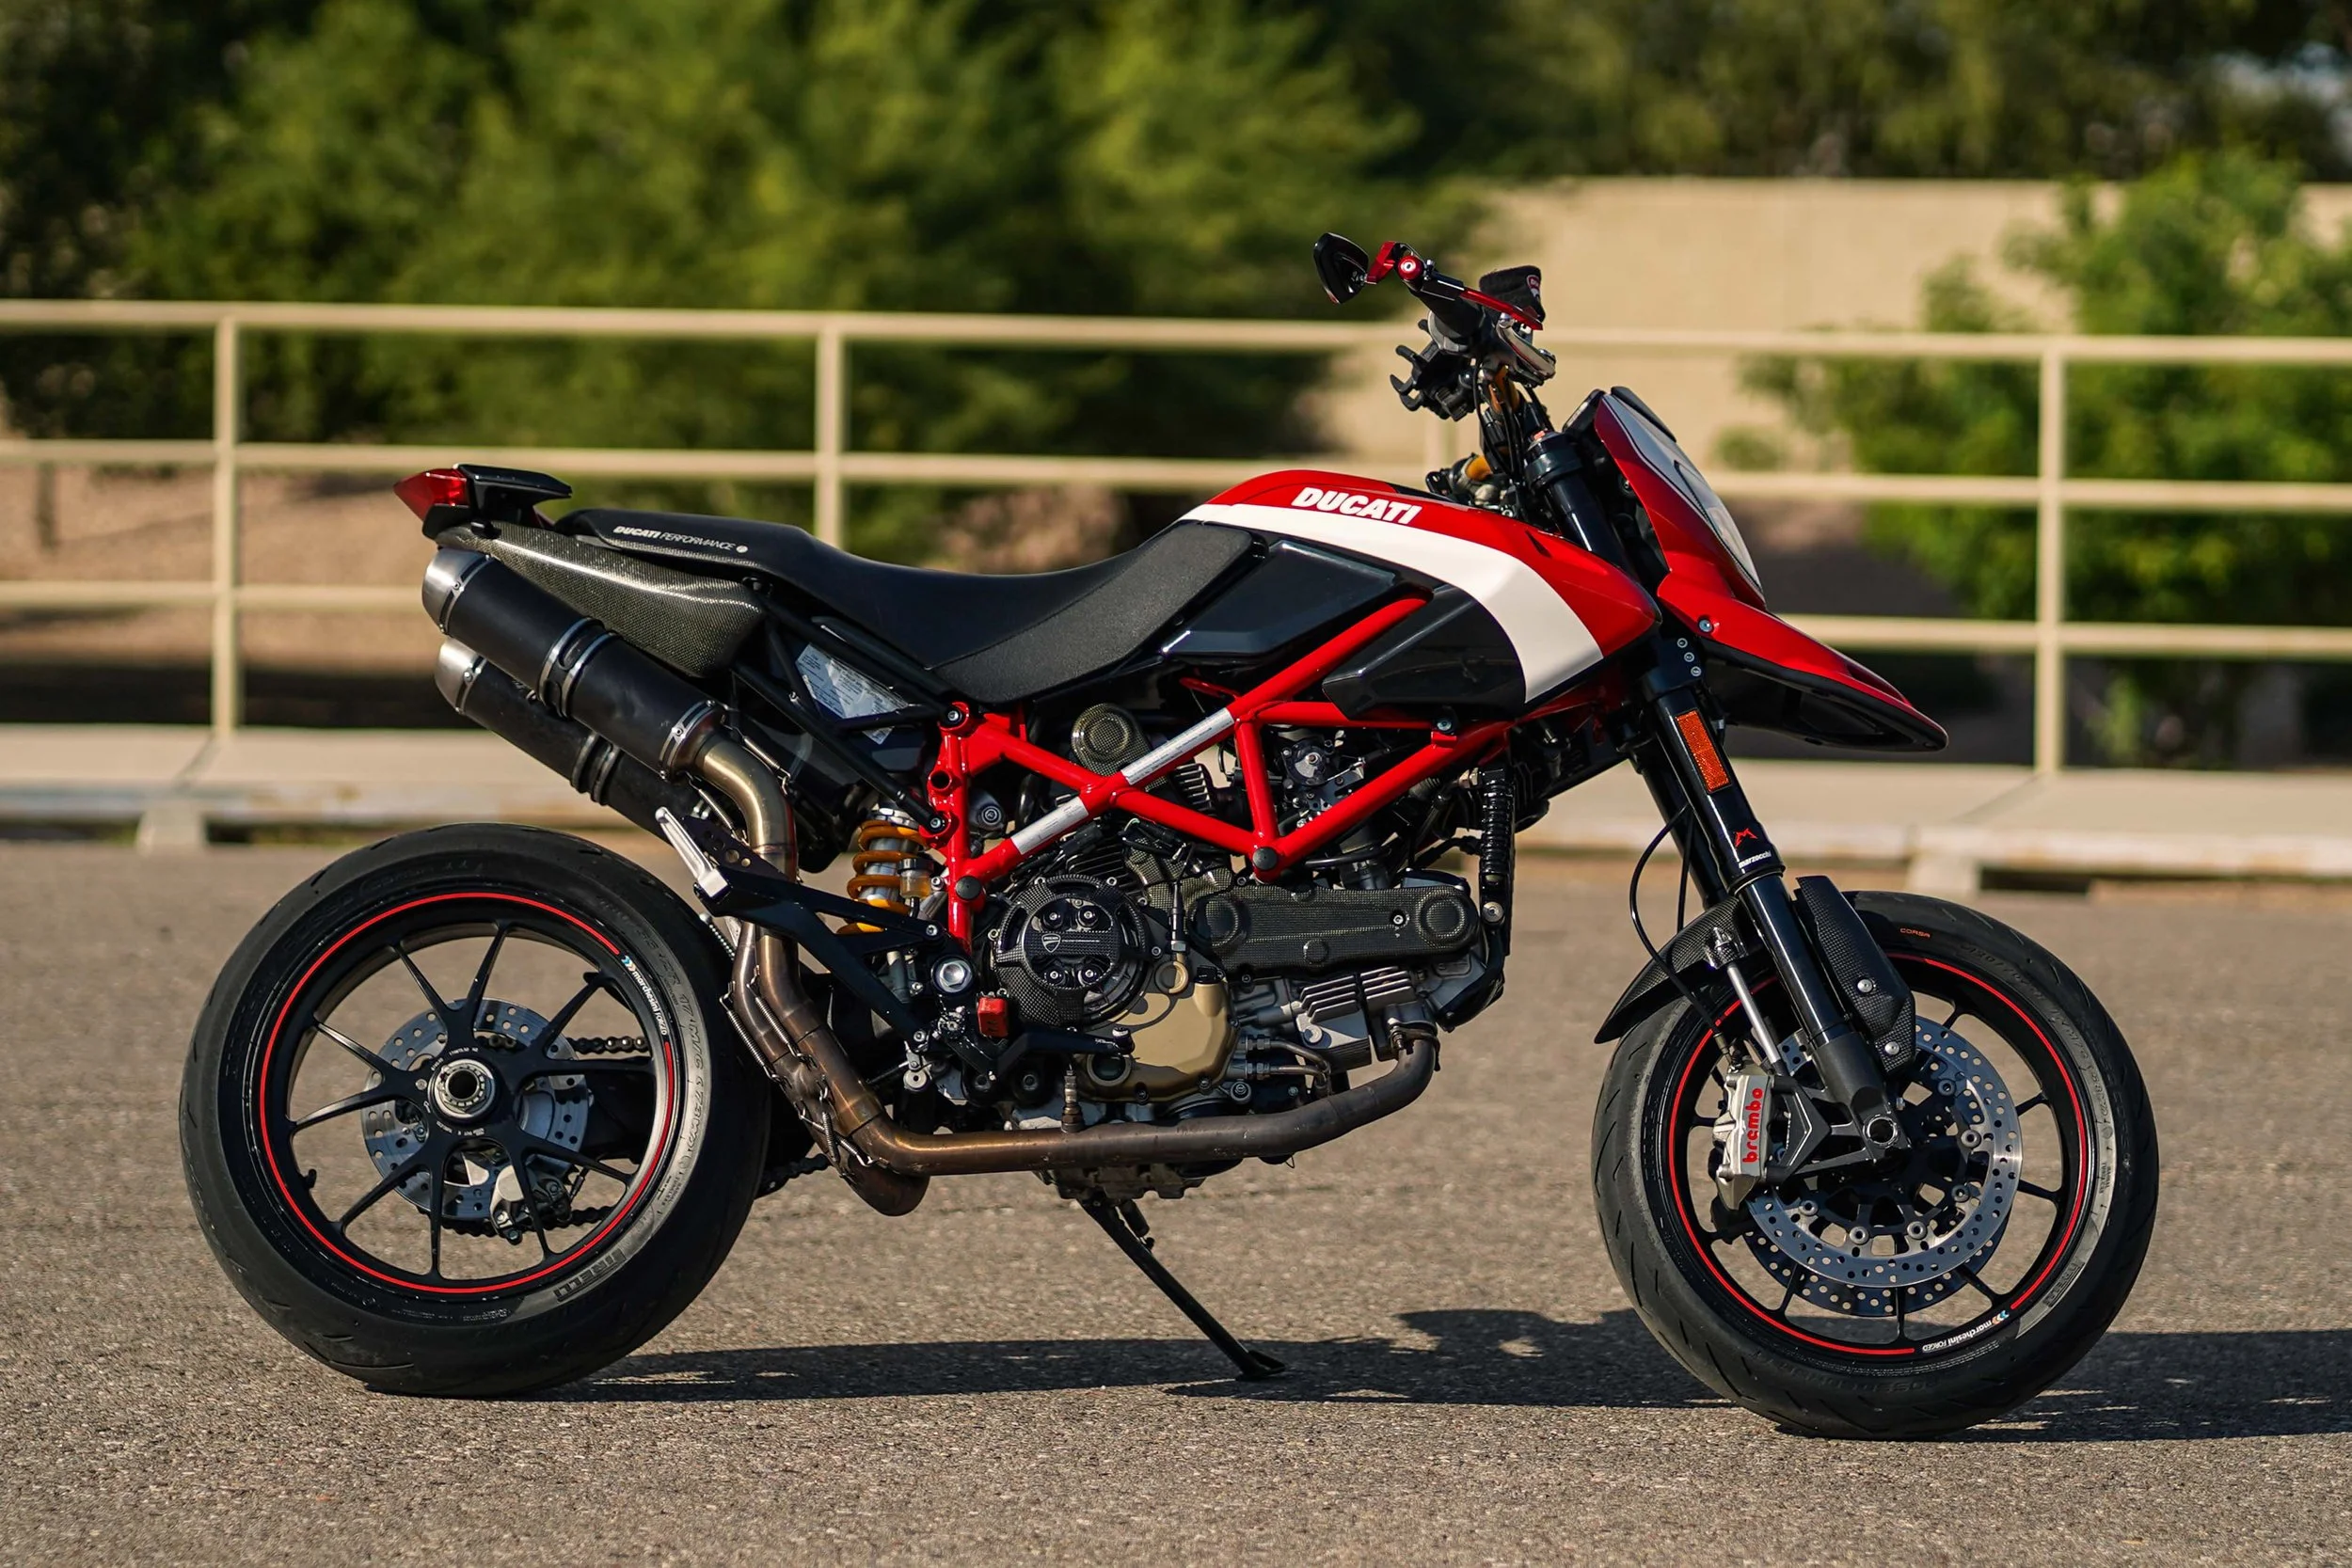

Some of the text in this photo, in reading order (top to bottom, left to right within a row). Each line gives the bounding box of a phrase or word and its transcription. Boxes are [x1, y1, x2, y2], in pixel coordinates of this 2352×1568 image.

[1290, 486, 1422, 525] DUCATI
[613, 525, 736, 550] DUCATI PERFORMANCE
[1739, 850, 1772, 868] marzocchi
[1899, 927, 1931, 939] CORSA
[631, 971, 661, 1013] marchesini
[1741, 1087, 1765, 1163] brembo
[553, 1247, 627, 1304] PIRELLI
[1922, 1320, 1992, 1353] marchesini FORGED
